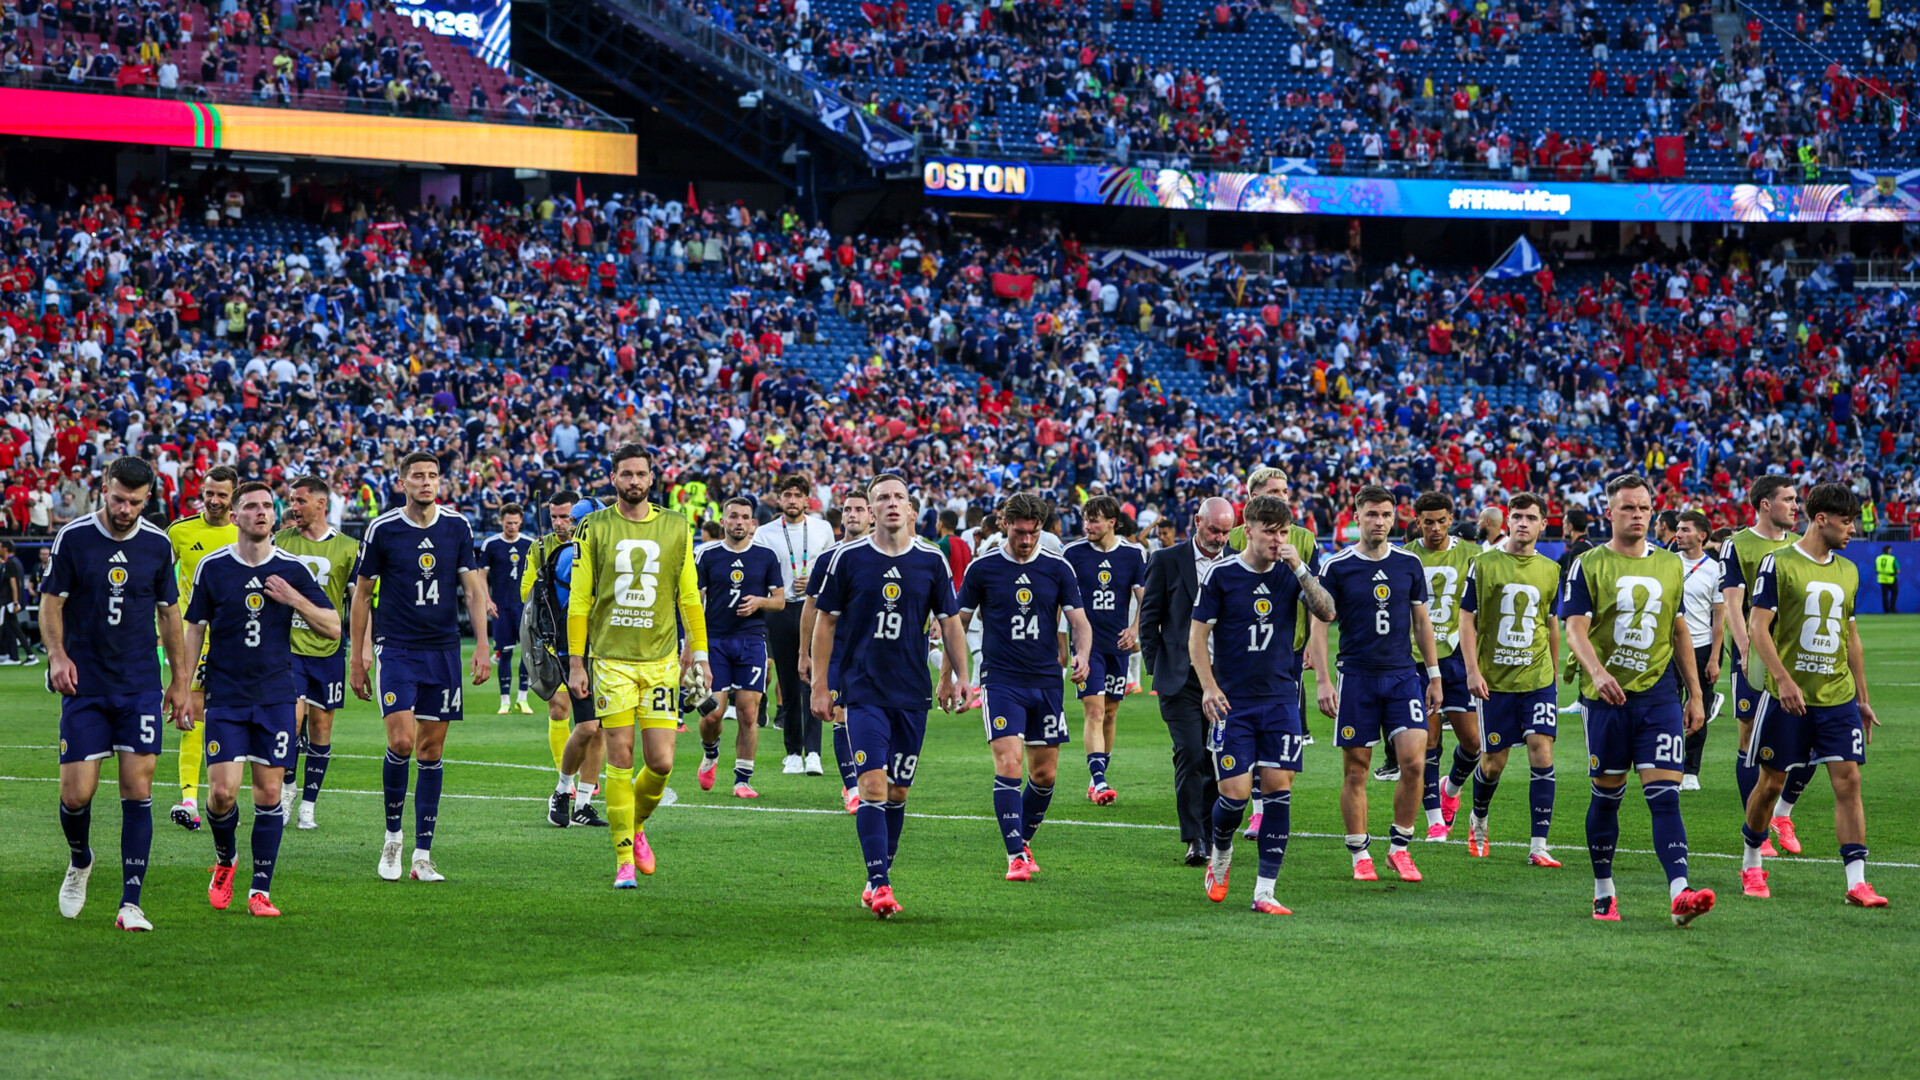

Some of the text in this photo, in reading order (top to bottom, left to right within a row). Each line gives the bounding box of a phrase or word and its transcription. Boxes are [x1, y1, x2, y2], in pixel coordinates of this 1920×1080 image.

[924, 161, 1025, 194] OSTON
[1448, 188, 1571, 215] #FIFAWorldCup
[415, 580, 440, 606] 14
[625, 592, 645, 601] FIFA
[729, 588, 741, 608] 7
[1093, 590, 1115, 611] 22
[108, 596, 124, 625] 5
[610, 616, 654, 629] 2026
[612, 608, 655, 617] WORLD CUP
[1375, 609, 1390, 636] 6
[244, 619, 262, 648] 3
[873, 611, 903, 640] 19
[1011, 615, 1040, 640] 24
[1247, 623, 1274, 652] 17
[1507, 634, 1526, 642] FIFA
[1495, 648, 1520, 656] WORLD
[1812, 637, 1831, 647] FIFA
[1493, 654, 1533, 666] 2026
[1633, 651, 1650, 661] CUP
[1794, 661, 1835, 675] 2026
[1797, 652, 1826, 663] WORLD
[749, 666, 762, 686] 7
[1105, 674, 1127, 696] 22
[327, 681, 343, 705] 16
[440, 687, 462, 714] 14
[652, 687, 676, 713] 21
[1409, 698, 1424, 723] 6
[1533, 702, 1556, 727] 25
[140, 714, 155, 744] 5
[1043, 711, 1068, 739] 24
[273, 731, 289, 759] 3
[1279, 734, 1302, 762] 17
[1655, 733, 1683, 763] 20
[1851, 728, 1863, 755] 2
[893, 752, 919, 780] 19
[125, 858, 145, 867] ALBA
